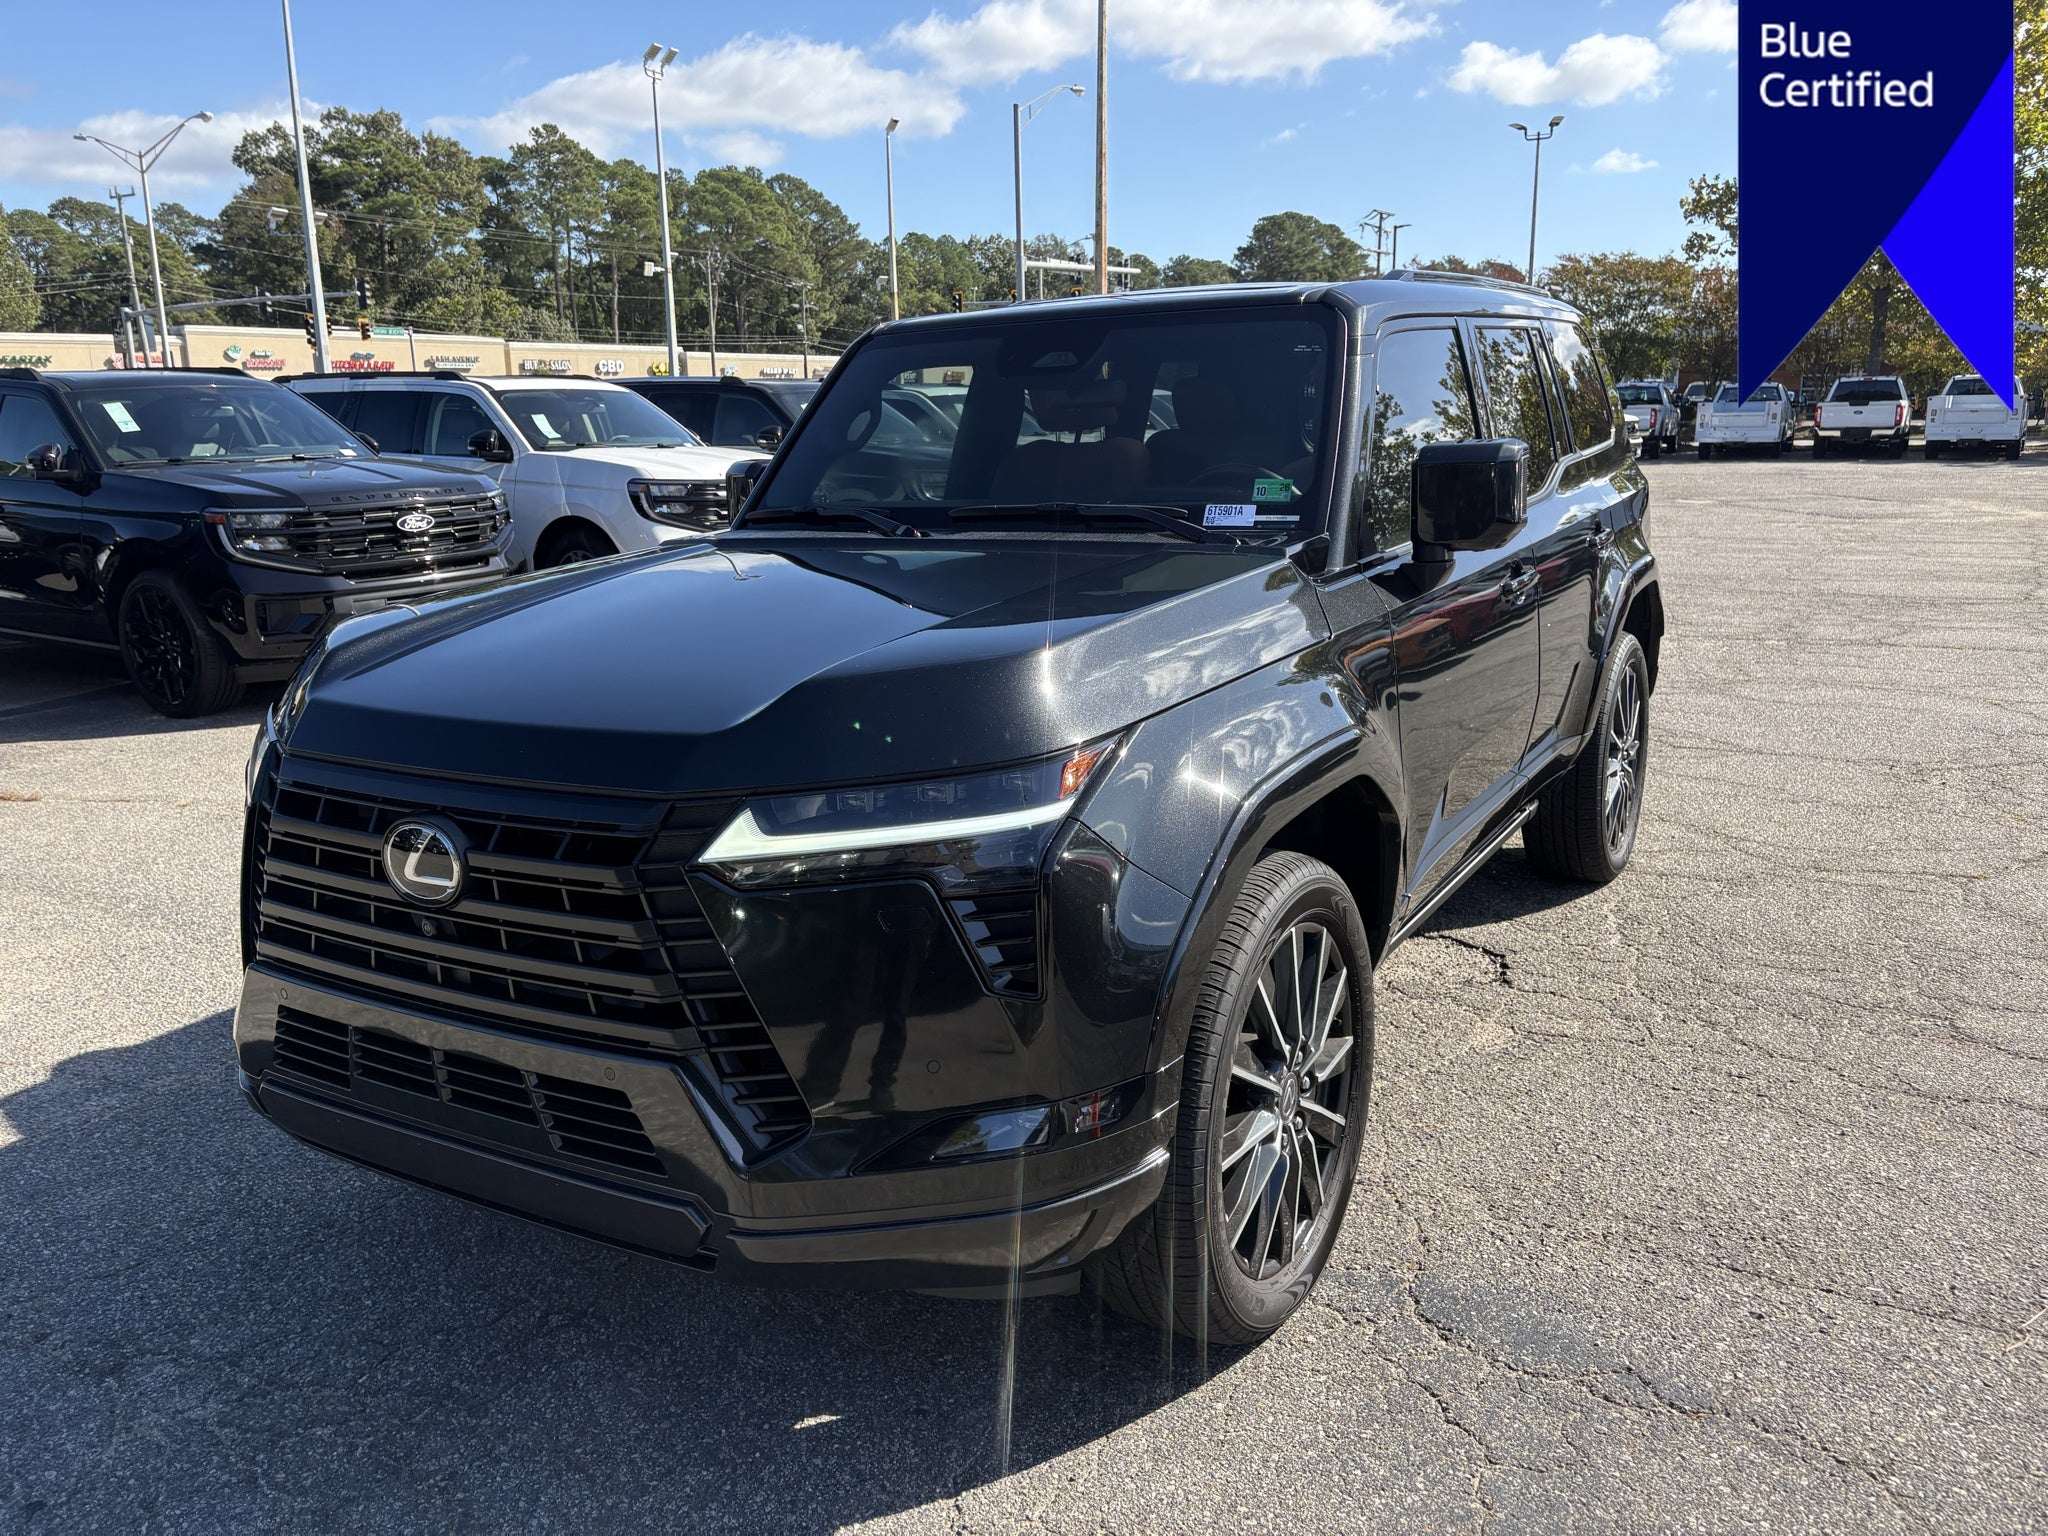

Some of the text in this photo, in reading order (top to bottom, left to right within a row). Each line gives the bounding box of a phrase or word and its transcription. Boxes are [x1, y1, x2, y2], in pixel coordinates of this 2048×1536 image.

[1255, 486, 1267, 496] 10
[1207, 505, 1244, 516] 6T5901A
[404, 517, 428, 529] Ford
